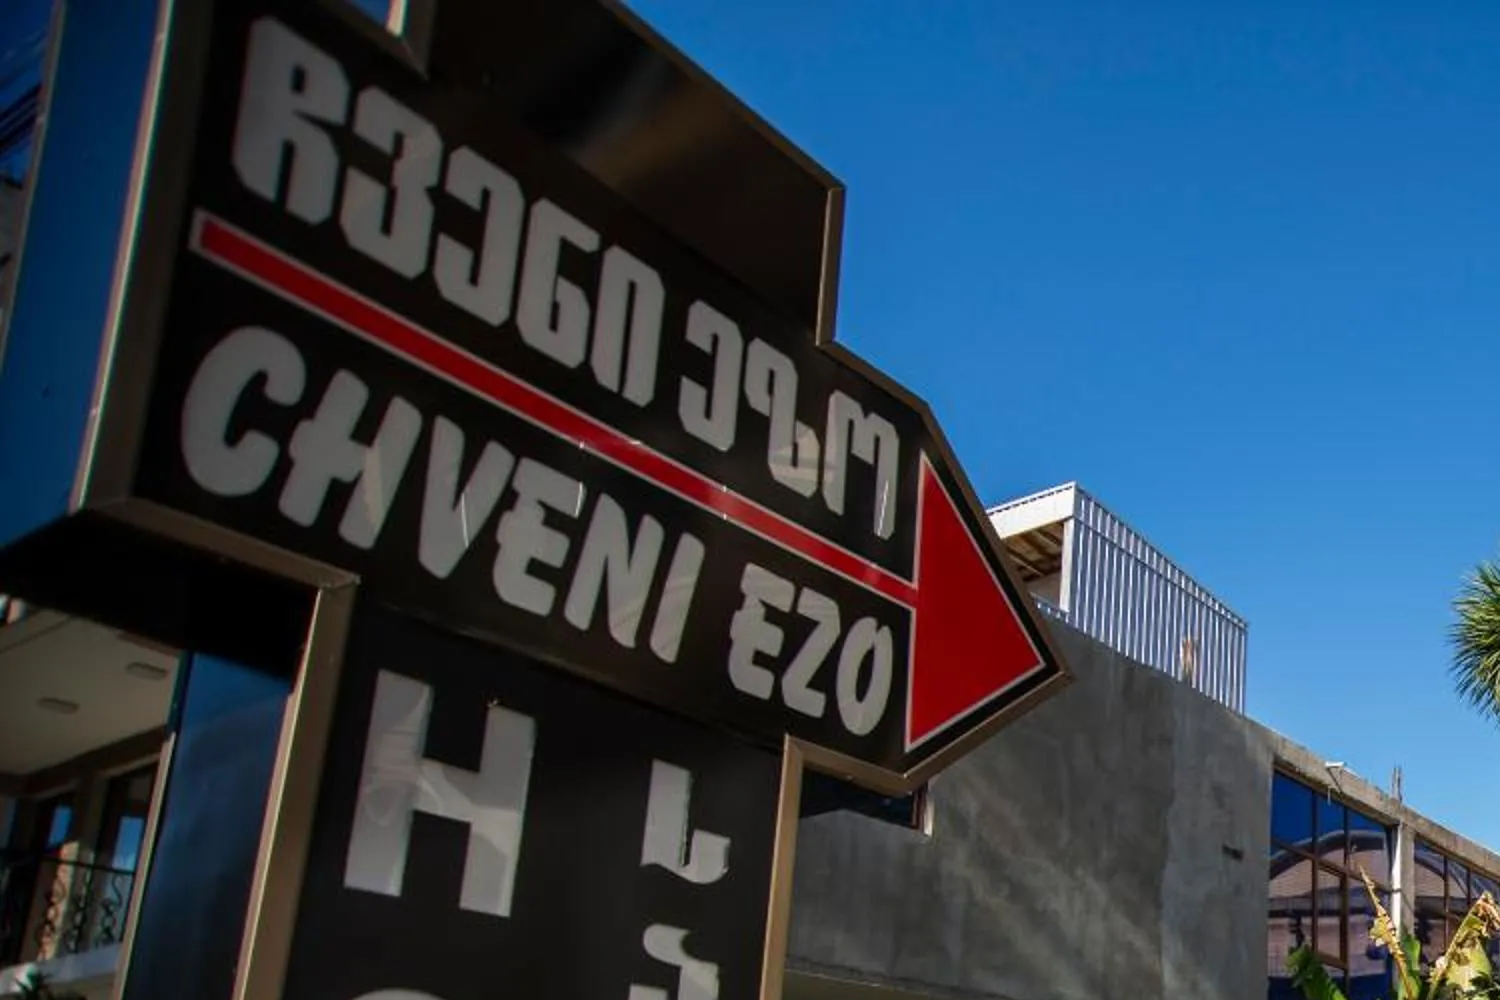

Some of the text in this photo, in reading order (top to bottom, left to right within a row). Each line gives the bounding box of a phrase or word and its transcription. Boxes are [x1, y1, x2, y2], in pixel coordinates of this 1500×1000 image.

[232, 15, 899, 540] ჩვენი ეზო
[180, 326, 895, 736] CHVENI EZO
